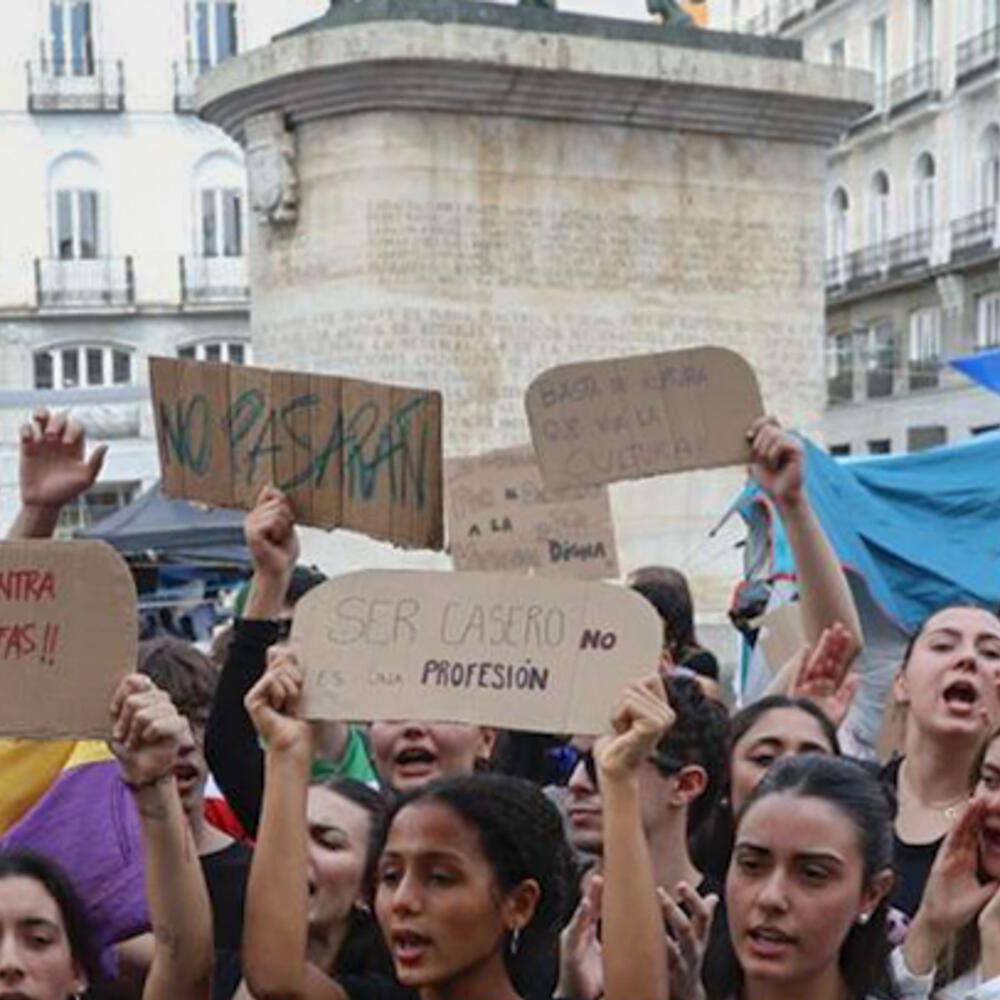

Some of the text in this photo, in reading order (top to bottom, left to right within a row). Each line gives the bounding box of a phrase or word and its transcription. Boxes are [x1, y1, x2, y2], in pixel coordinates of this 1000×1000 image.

[160, 393, 211, 475] NO
[327, 599, 617, 651] SER CASERO NO
[420, 657, 550, 692] PROFESIÓN
